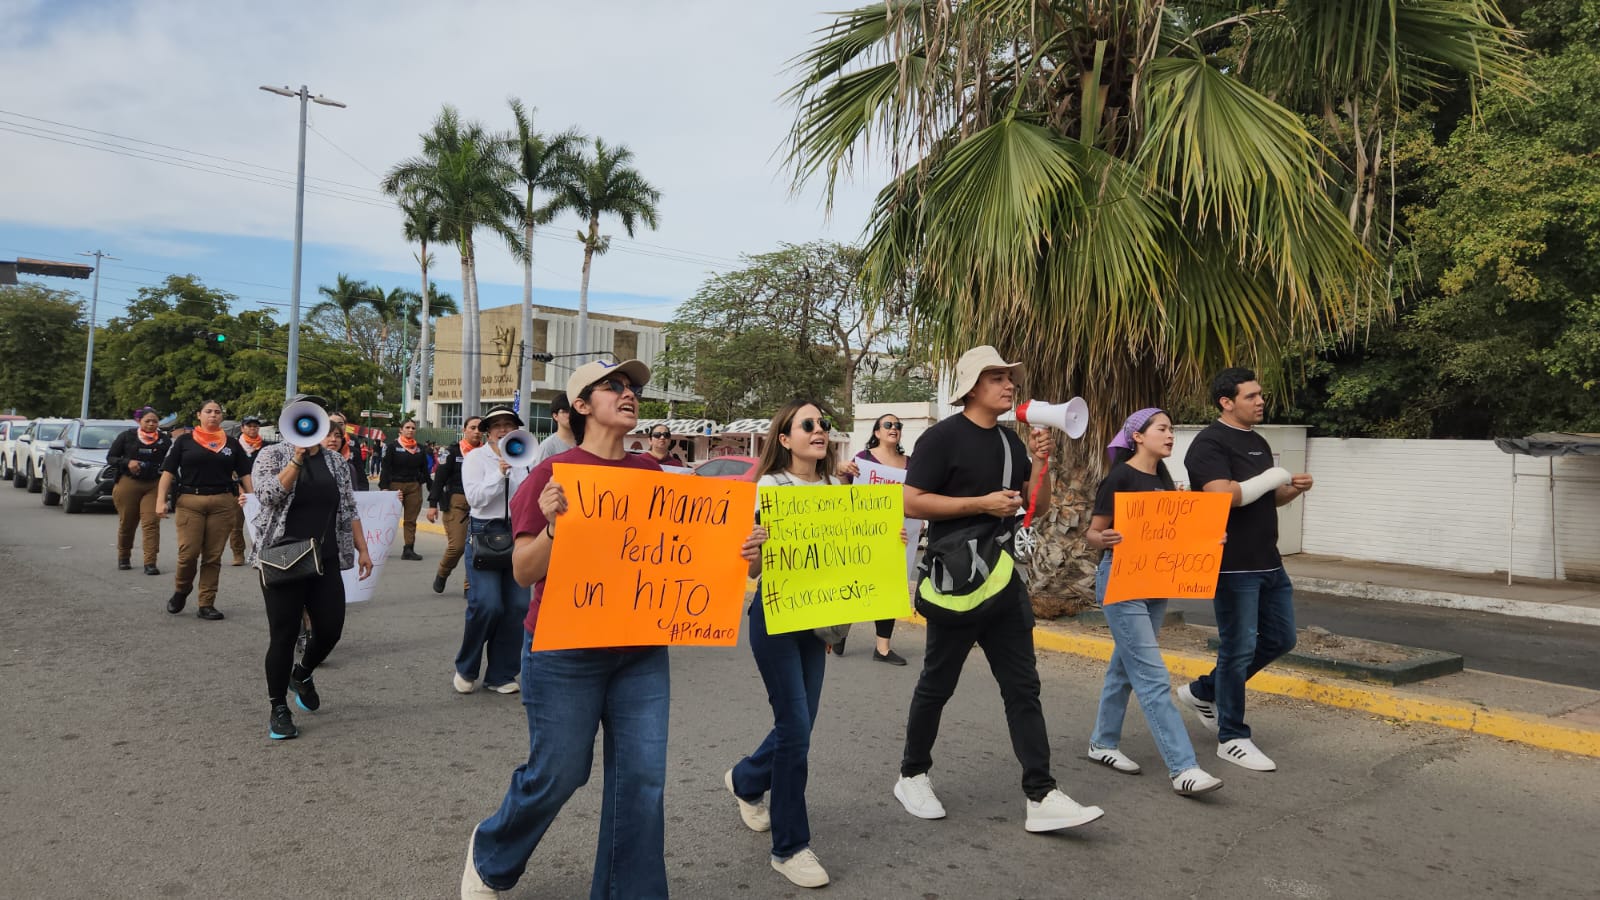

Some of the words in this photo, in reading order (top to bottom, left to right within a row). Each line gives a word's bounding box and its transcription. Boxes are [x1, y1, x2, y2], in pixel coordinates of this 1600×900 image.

[577, 480, 629, 521] Una
[620, 526, 693, 565] Perdió
[573, 581, 604, 608] un
[669, 621, 735, 642] #Píndaro
